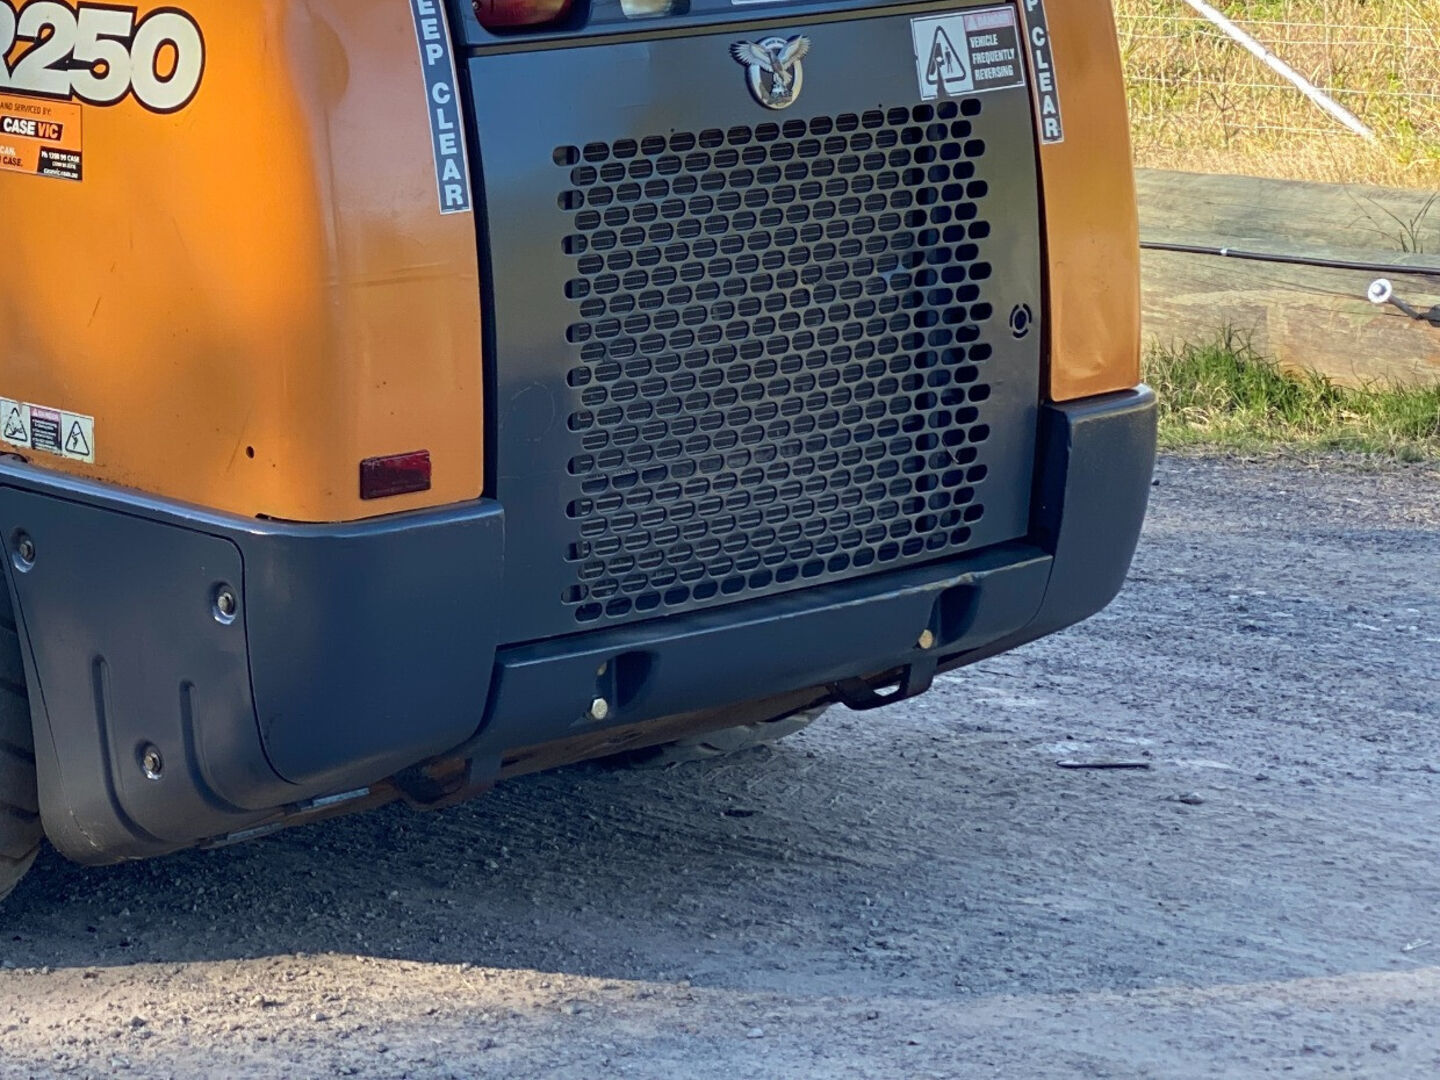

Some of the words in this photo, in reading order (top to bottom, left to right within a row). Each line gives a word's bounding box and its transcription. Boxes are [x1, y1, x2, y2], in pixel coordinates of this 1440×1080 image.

[969, 34, 998, 48] VEHICLE
[972, 48, 1015, 65] FREQUENTLY
[974, 64, 1014, 81] REVERSING
[1032, 26, 1059, 138] CLEAR
[0, 101, 14, 111] AND
[14, 103, 41, 114] SERVICED
[3, 117, 35, 135] CASE
[37, 122, 59, 138] VIC
[432, 81, 464, 206] CLEAR
